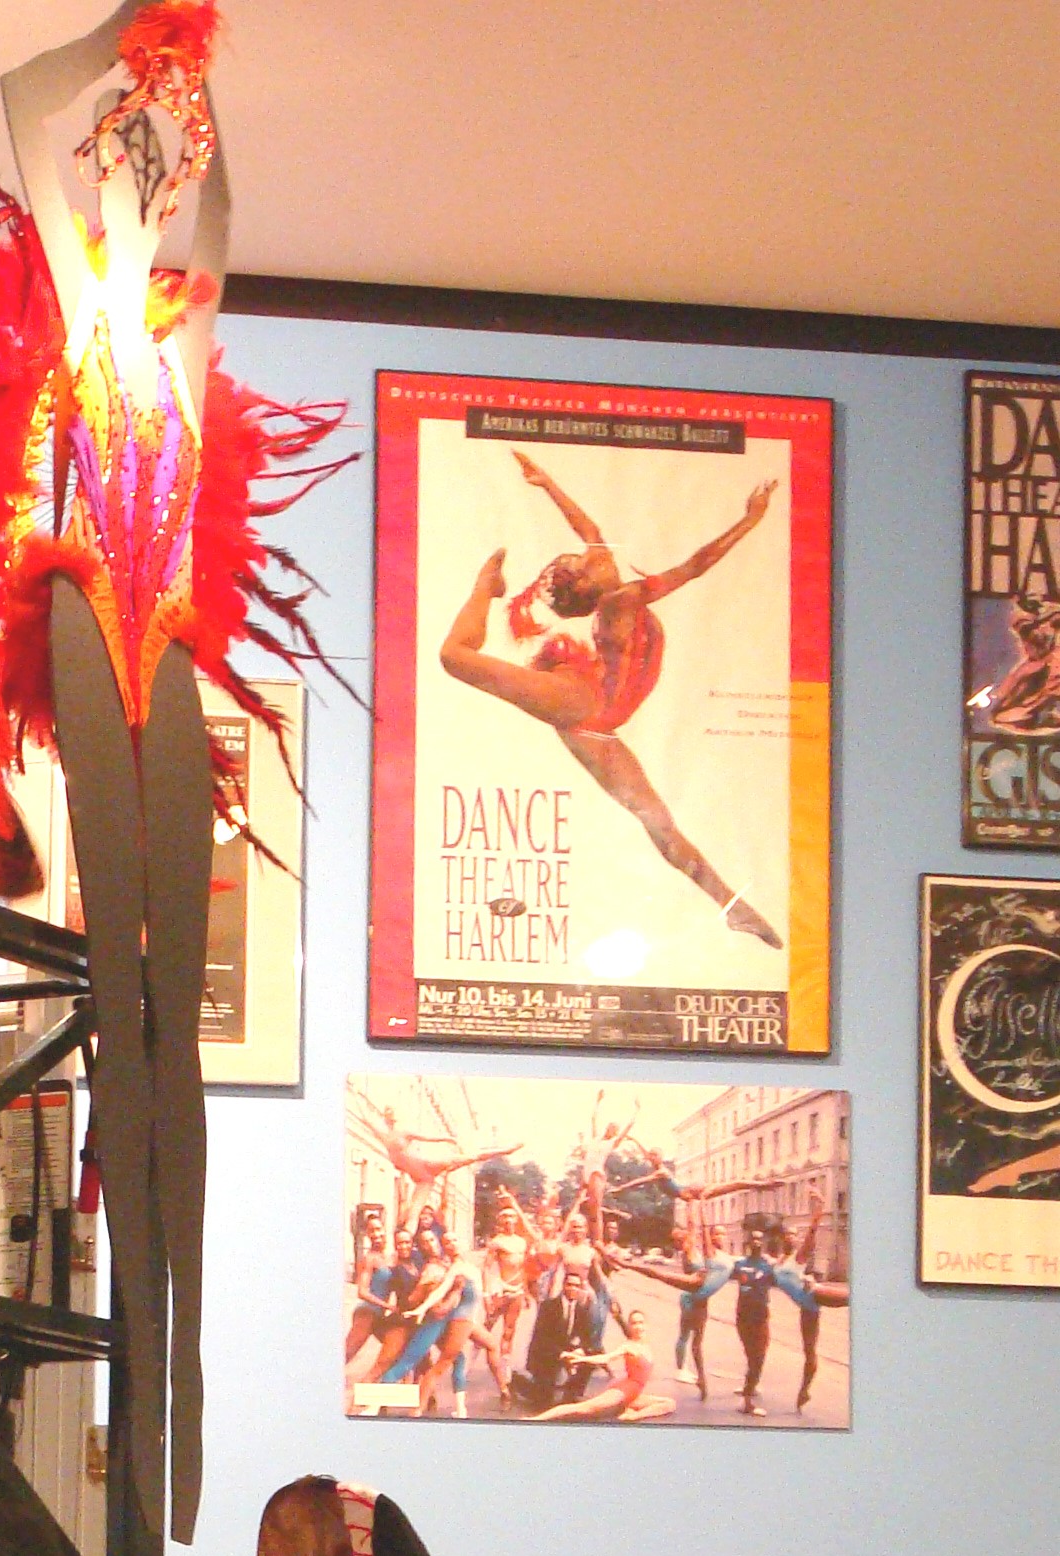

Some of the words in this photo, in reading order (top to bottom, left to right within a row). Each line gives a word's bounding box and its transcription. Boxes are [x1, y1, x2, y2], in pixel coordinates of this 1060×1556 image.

[440, 785, 572, 855] DANCE
[440, 855, 570, 909] THEATRE
[444, 909, 569, 965] HARLEM
[418, 984, 457, 1003] Nur
[458, 985, 486, 1005] 10.
[488, 985, 517, 1007] bis
[521, 989, 550, 1008] 14.
[551, 990, 592, 1009] Juni
[674, 993, 782, 1016] DEUTSCHES
[675, 1015, 785, 1046] THEATER
[936, 1251, 1013, 1273] DANCE
